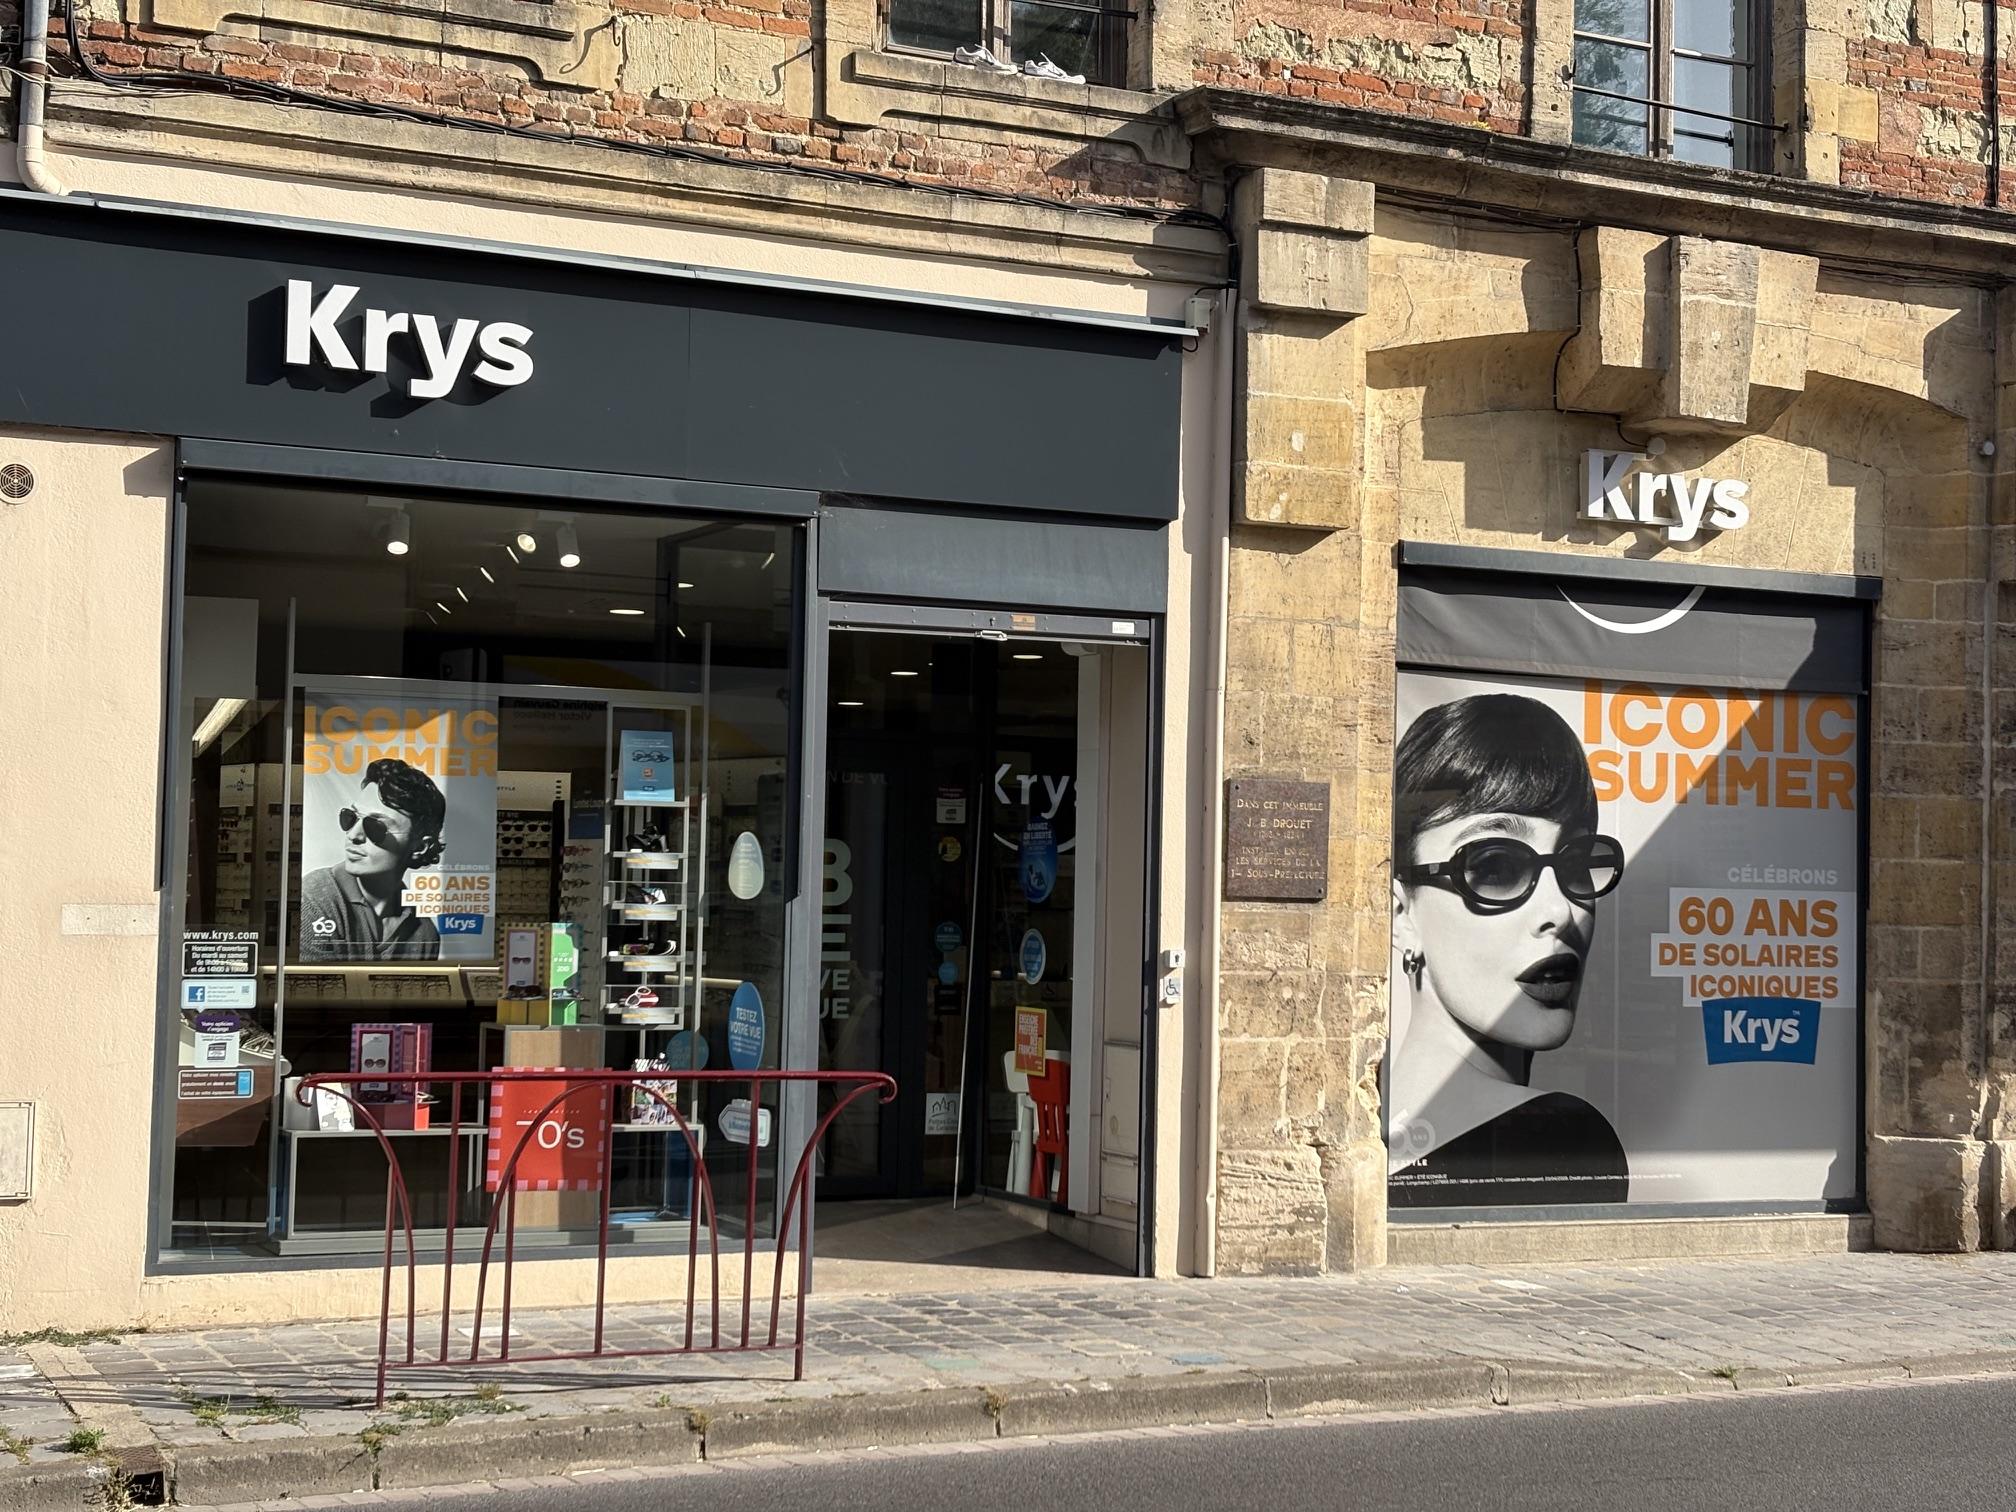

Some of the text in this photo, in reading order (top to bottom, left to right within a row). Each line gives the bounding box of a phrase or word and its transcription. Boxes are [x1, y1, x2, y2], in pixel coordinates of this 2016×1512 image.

[286, 279, 534, 399] Krys
[1588, 449, 1750, 541] Krys
[304, 706, 497, 746] ICONIC
[1584, 680, 1856, 756] ICONIC
[995, 764, 1077, 819] Kry
[1586, 749, 1856, 811] SUMMER
[1273, 818, 1313, 829] DROUET
[415, 876, 490, 891] 60 ANS
[1728, 864, 1838, 885] CÉLÉBRONS
[406, 893, 490, 903] DE SOLAIRES
[420, 905, 490, 914] ICONIQUES
[445, 917, 477, 931] Krys
[1679, 897, 1839, 938] 60 ANS
[183, 930, 259, 941] www.krys.com
[1659, 943, 1839, 968] DE SOLAIRES
[1691, 975, 1839, 999] ICONIQUES
[736, 1007, 757, 1023] TESTEZ
[730, 1021, 762, 1039] VOTRE VUE
[1723, 1010, 1801, 1051] Krys
